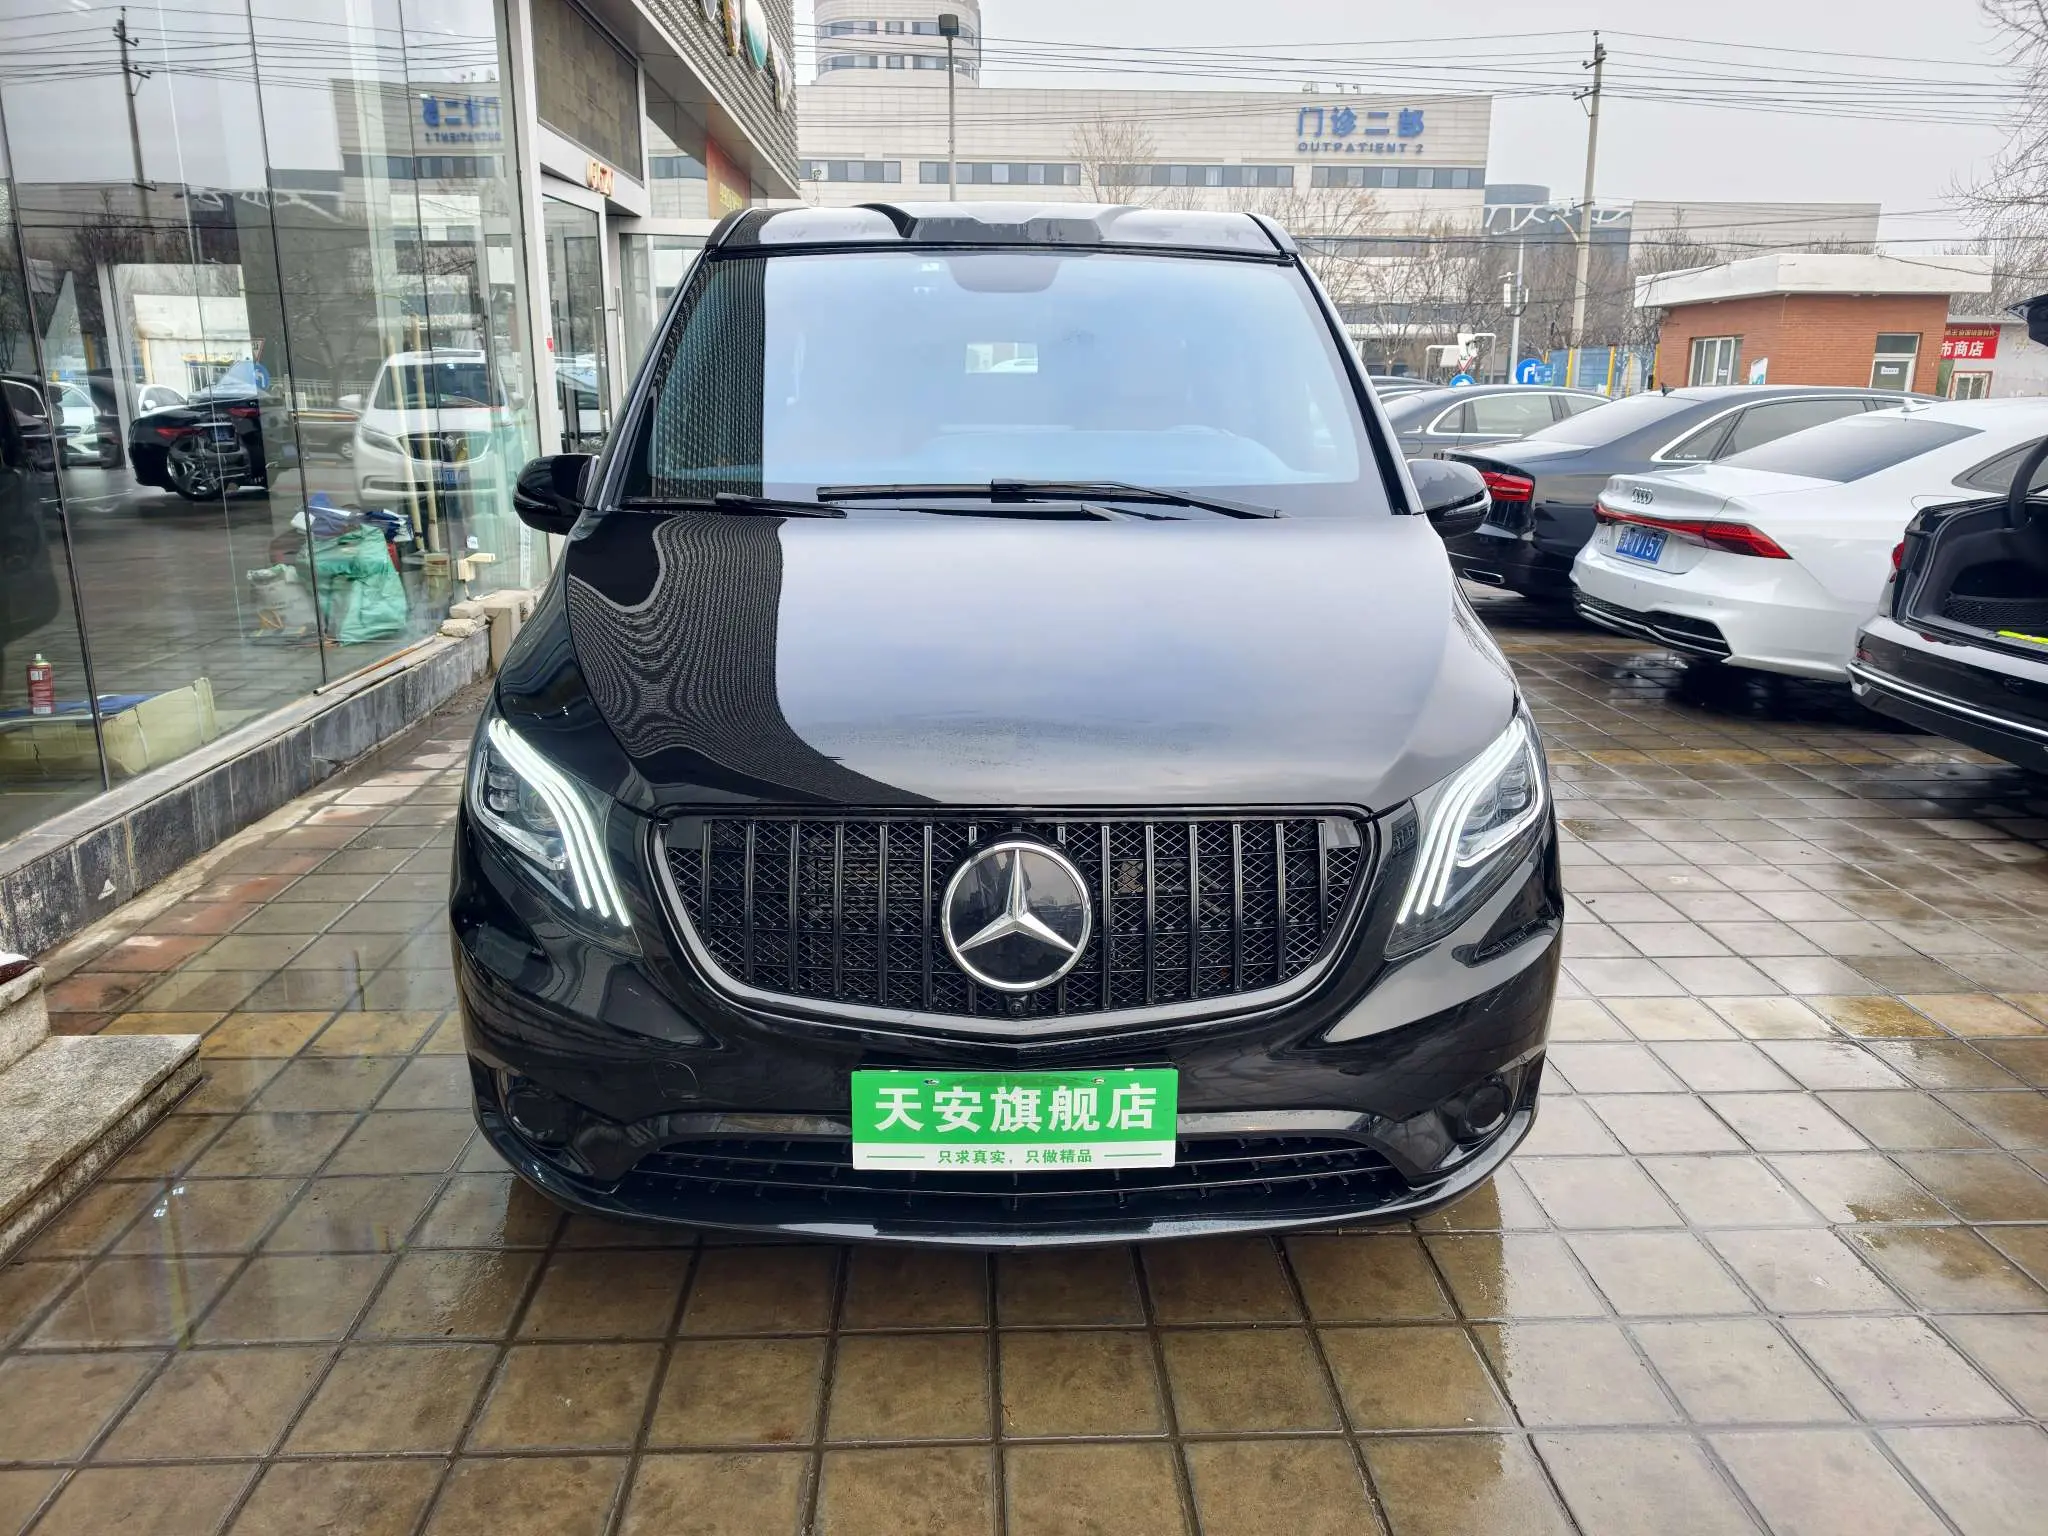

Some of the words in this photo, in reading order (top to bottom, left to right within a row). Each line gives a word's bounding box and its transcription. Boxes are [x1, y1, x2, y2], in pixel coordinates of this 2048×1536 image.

[1297, 106, 1424, 137] 门诊二部
[1298, 142, 1407, 153] OUTPATIENT
[1415, 143, 1424, 154] 2
[1941, 341, 1984, 357] 市商店
[875, 1083, 1157, 1133] 天安旗舰店
